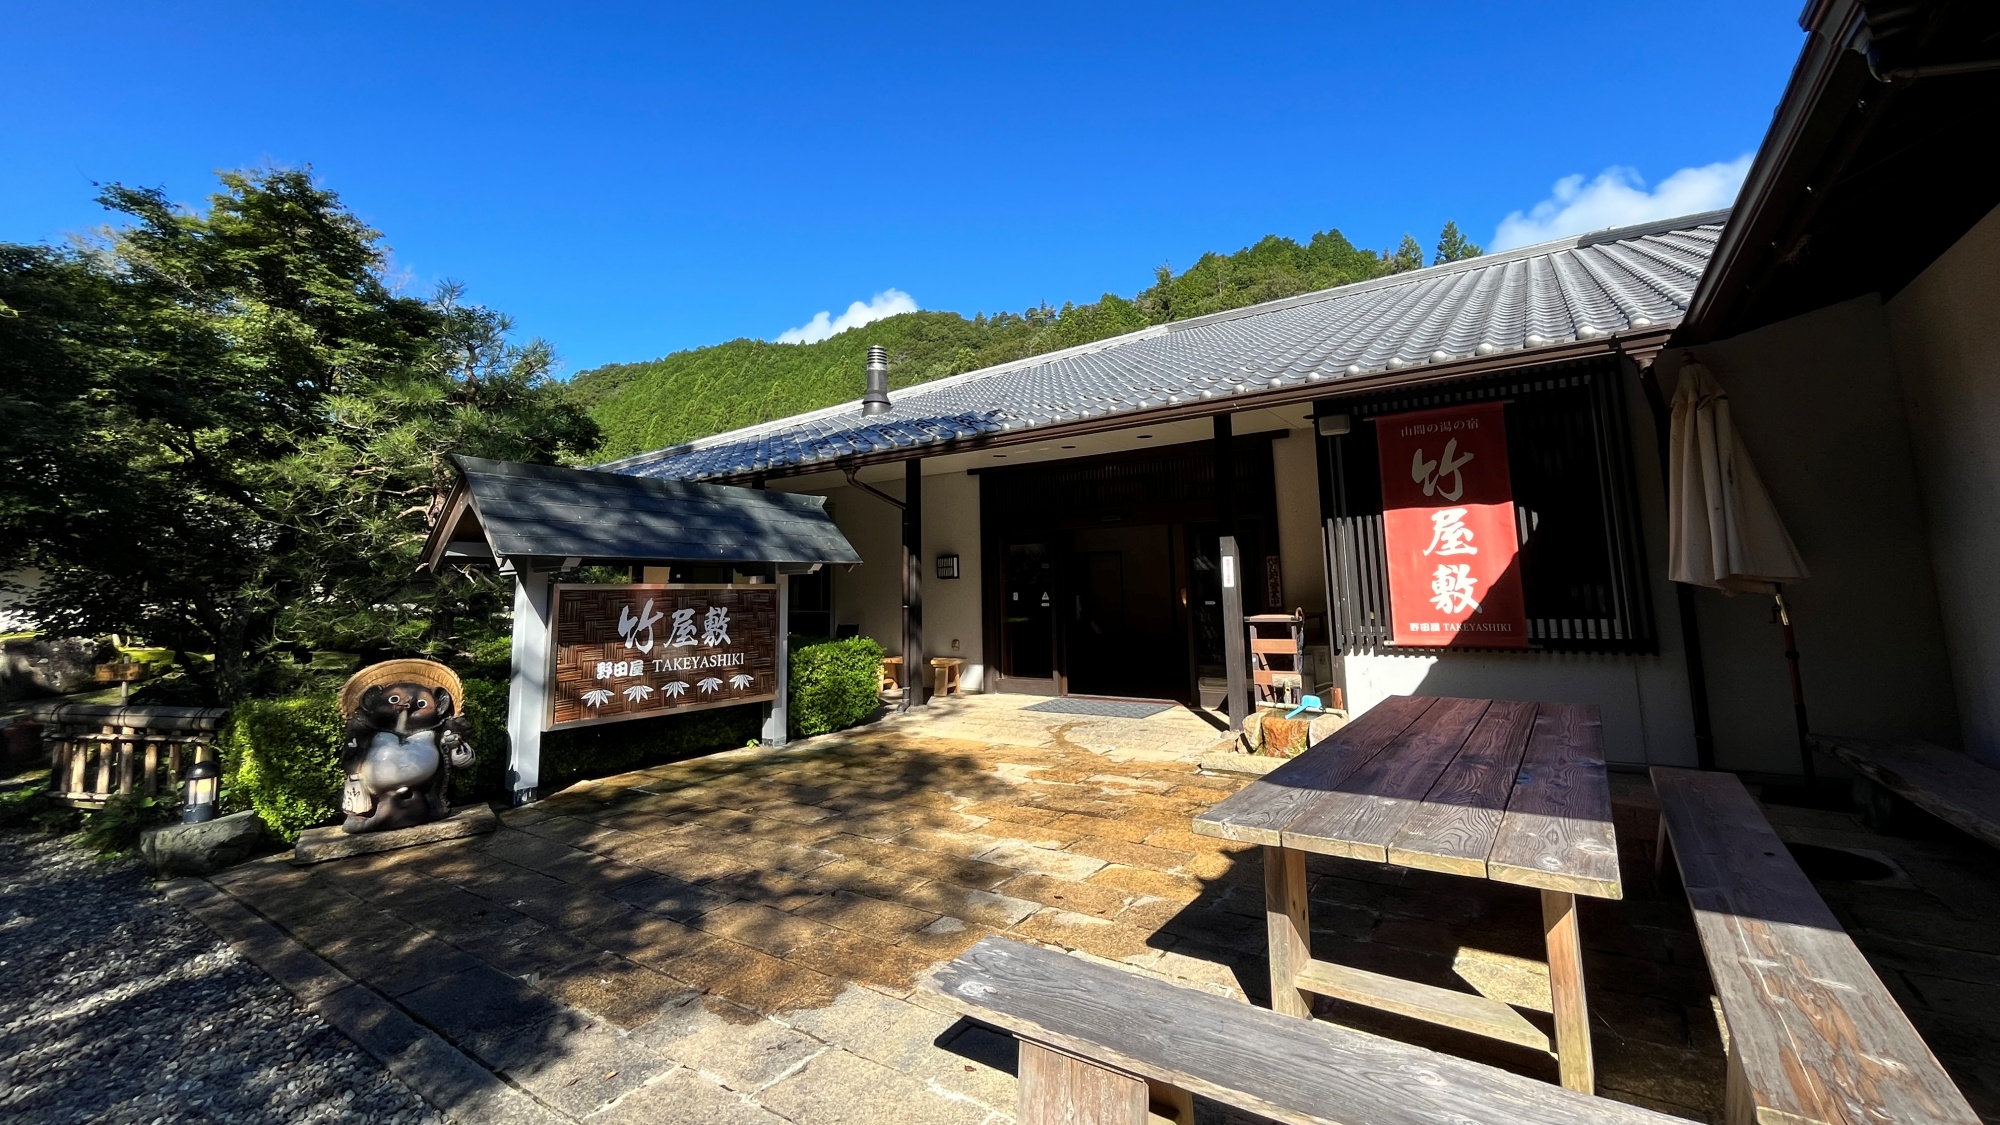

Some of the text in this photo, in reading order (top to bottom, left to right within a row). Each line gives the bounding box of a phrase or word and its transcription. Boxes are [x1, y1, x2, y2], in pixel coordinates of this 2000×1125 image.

[1401, 417, 1479, 437] 山間の湯の宿
[1411, 437, 1483, 614] 竹屋敷
[617, 597, 731, 654] 竹屋敷
[1442, 622, 1512, 632] TAKEYASHIKI
[596, 652, 745, 680] 野田屋 TAKEYASHIKI
